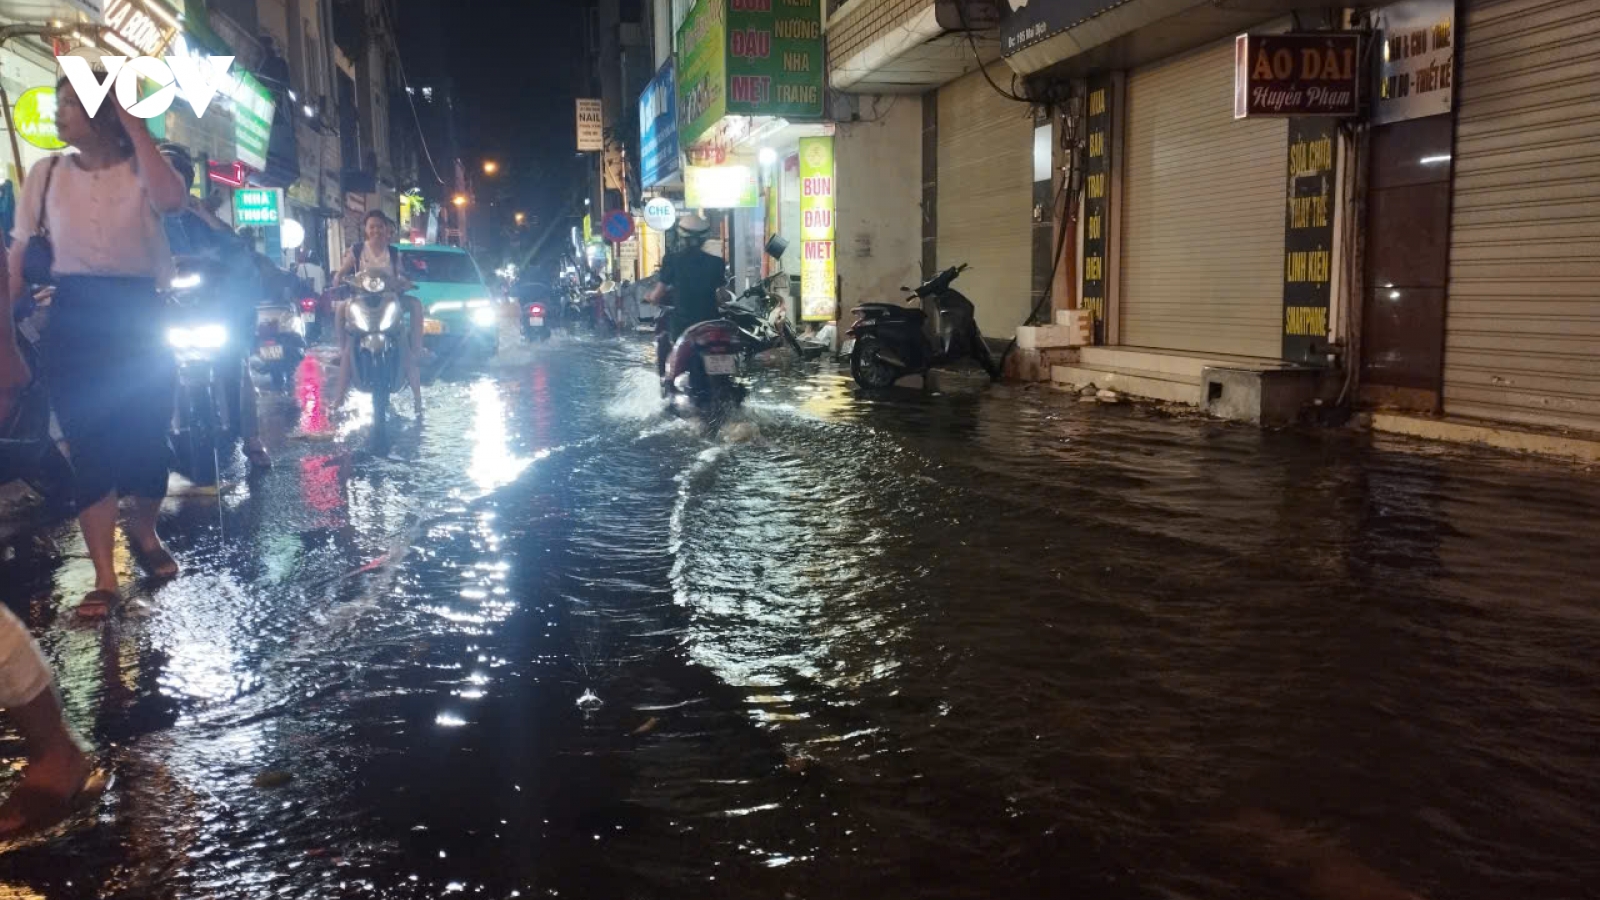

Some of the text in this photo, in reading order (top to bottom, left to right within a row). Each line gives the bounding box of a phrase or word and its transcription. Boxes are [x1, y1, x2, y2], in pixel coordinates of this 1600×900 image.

[775, 17, 819, 39] NƯỚNG
[730, 27, 771, 64] ĐẬU
[1251, 39, 1353, 80] ÁO DÀI
[783, 52, 810, 71] NHA
[730, 76, 771, 108] MẸT
[777, 85, 817, 103] TRANG
[1252, 83, 1303, 111] Huyền
[1304, 86, 1351, 109] Phạm
[579, 112, 601, 122] NAIL
[1287, 251, 1307, 282] LINH
[1285, 306, 1328, 336] SMARTPHONE
